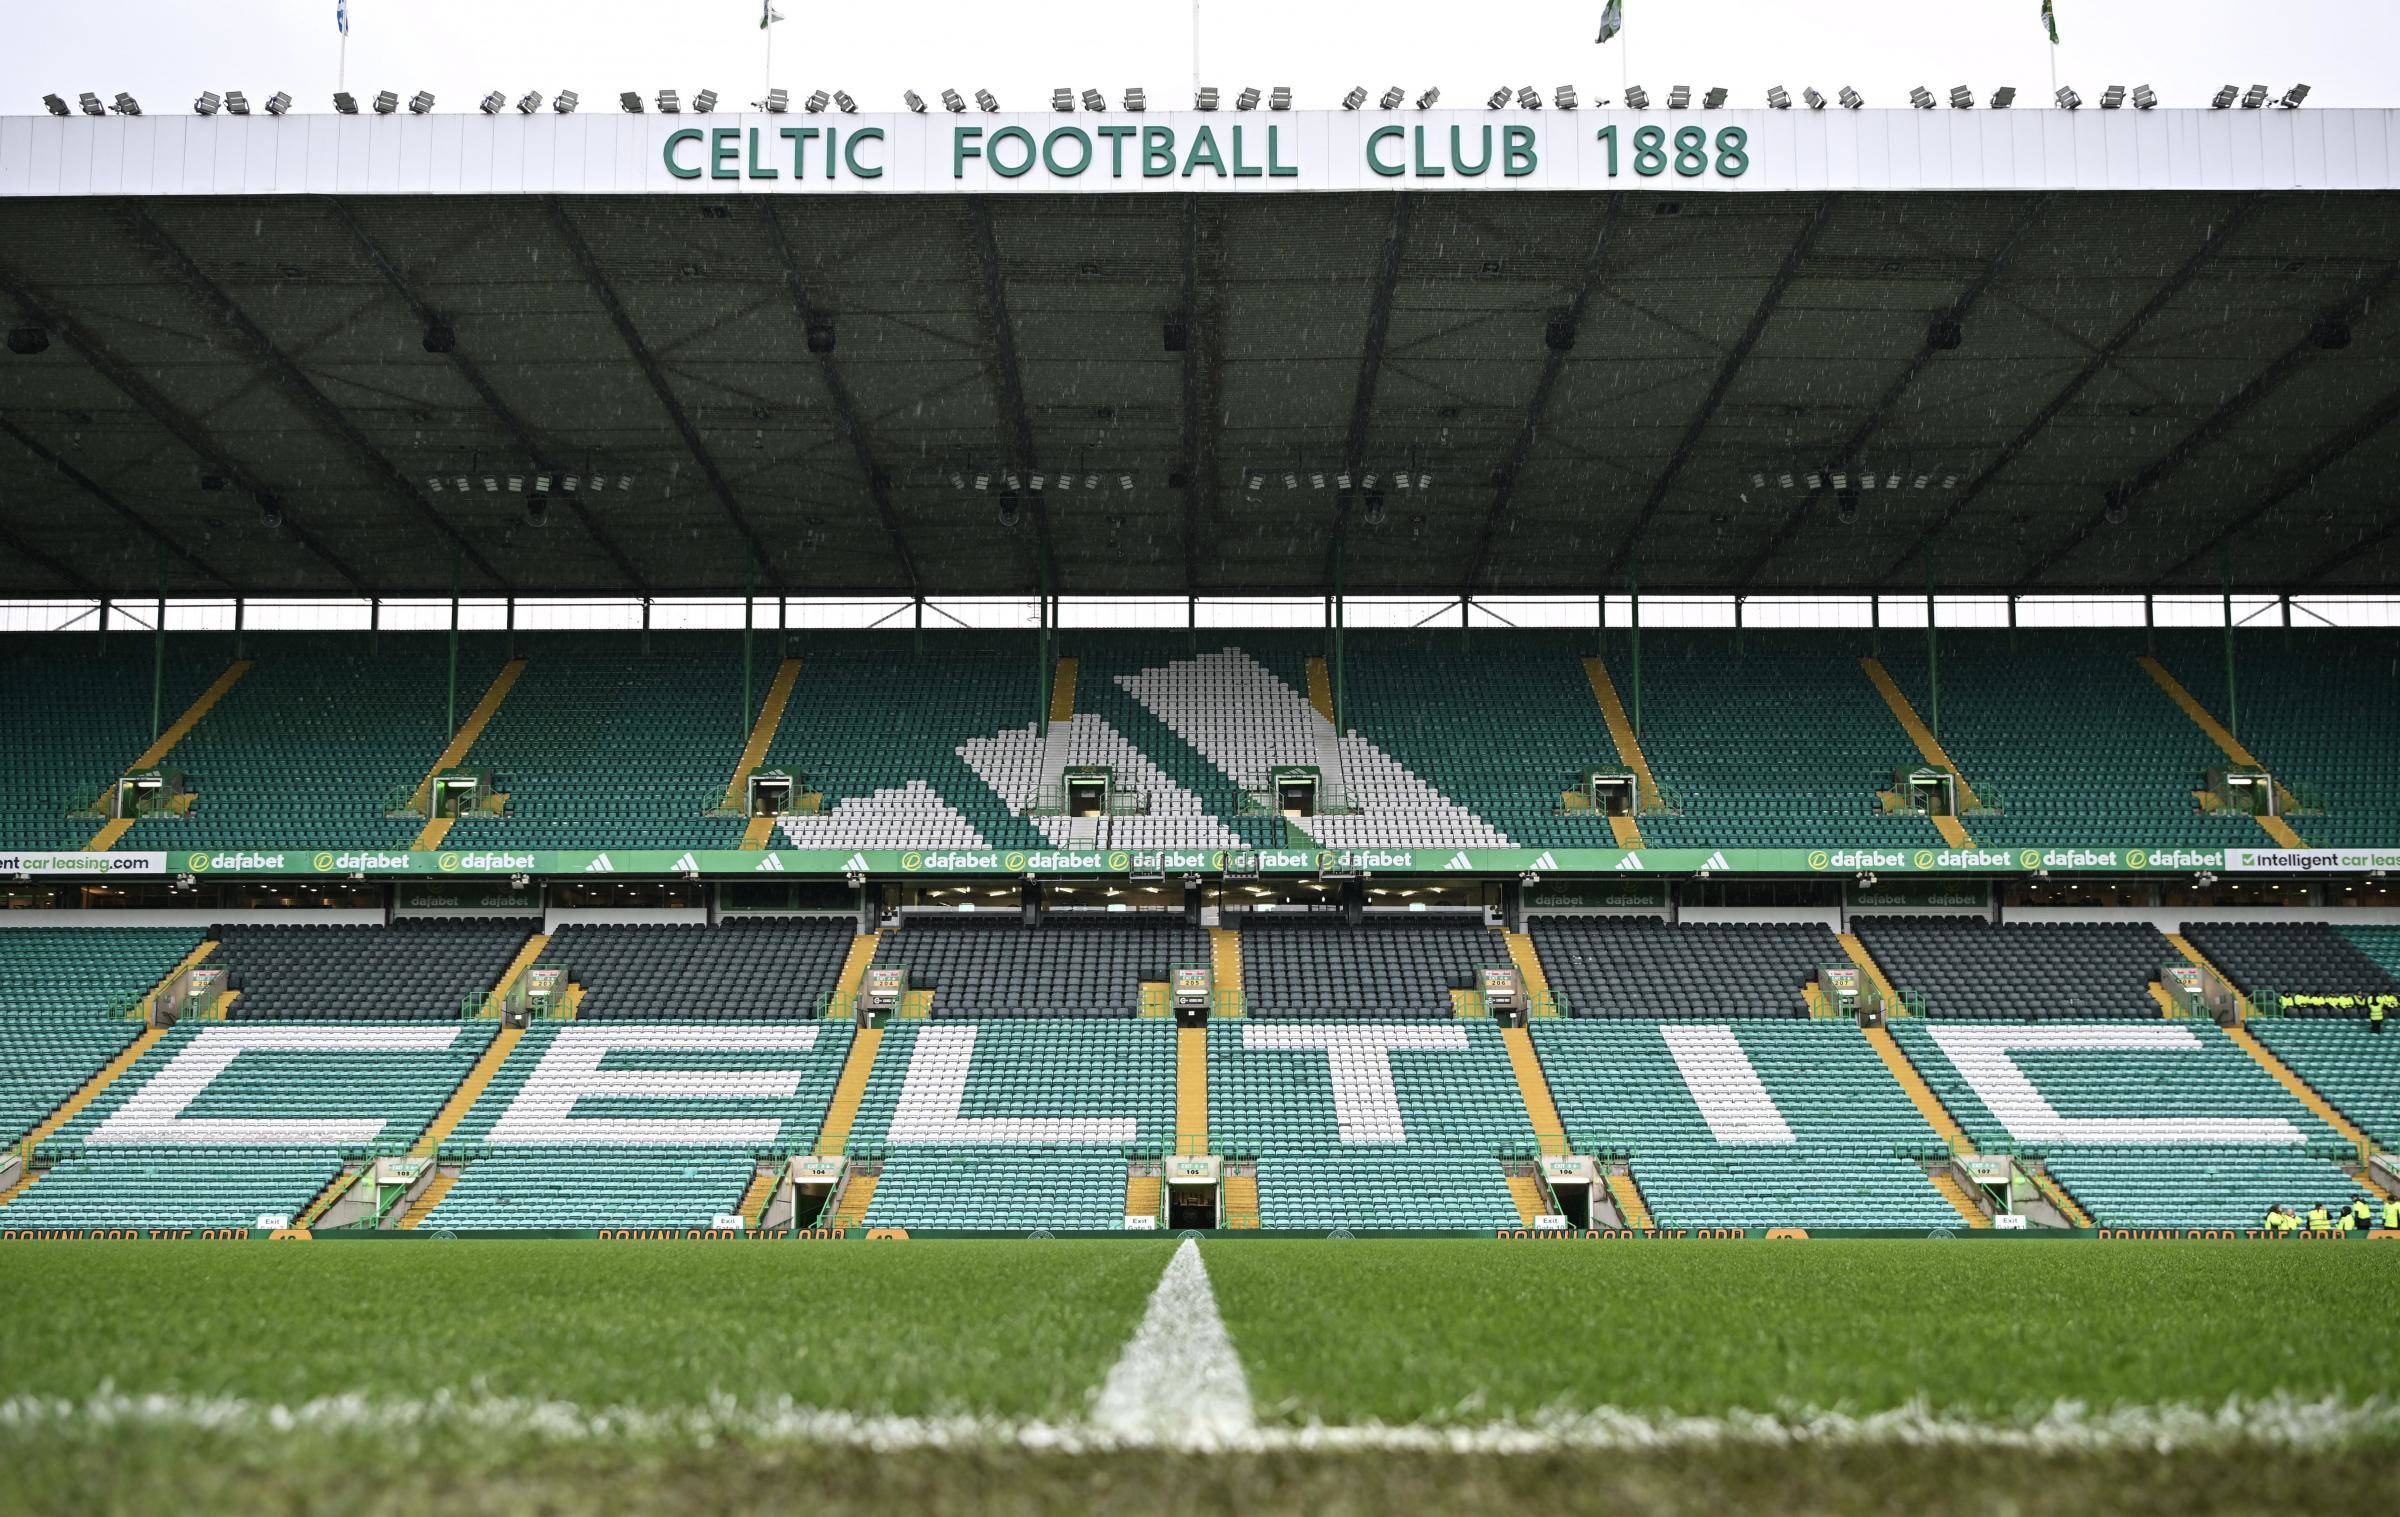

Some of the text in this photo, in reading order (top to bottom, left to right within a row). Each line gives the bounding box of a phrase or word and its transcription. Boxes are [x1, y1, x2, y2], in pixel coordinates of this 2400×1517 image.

[665, 124, 1750, 177] CELTIC FOOTBALL CLUB 1888
[23, 859, 49, 869] car
[211, 852, 285, 871] dafabet
[336, 852, 410, 871] dafabet
[461, 852, 535, 871] dafabet
[925, 851, 999, 870] dafabet
[1028, 851, 1102, 870] dafabet
[1131, 851, 1205, 870] dafabet
[1235, 851, 1309, 870] dafabet
[1338, 851, 1412, 870] dafabet
[1831, 849, 1905, 869] dafabet
[1937, 849, 2011, 869] dafabet
[2042, 849, 2116, 869] dafabet
[2148, 849, 2222, 869] dafabet
[2257, 853, 2338, 870] Intelligent
[2342, 856, 2368, 866] car
